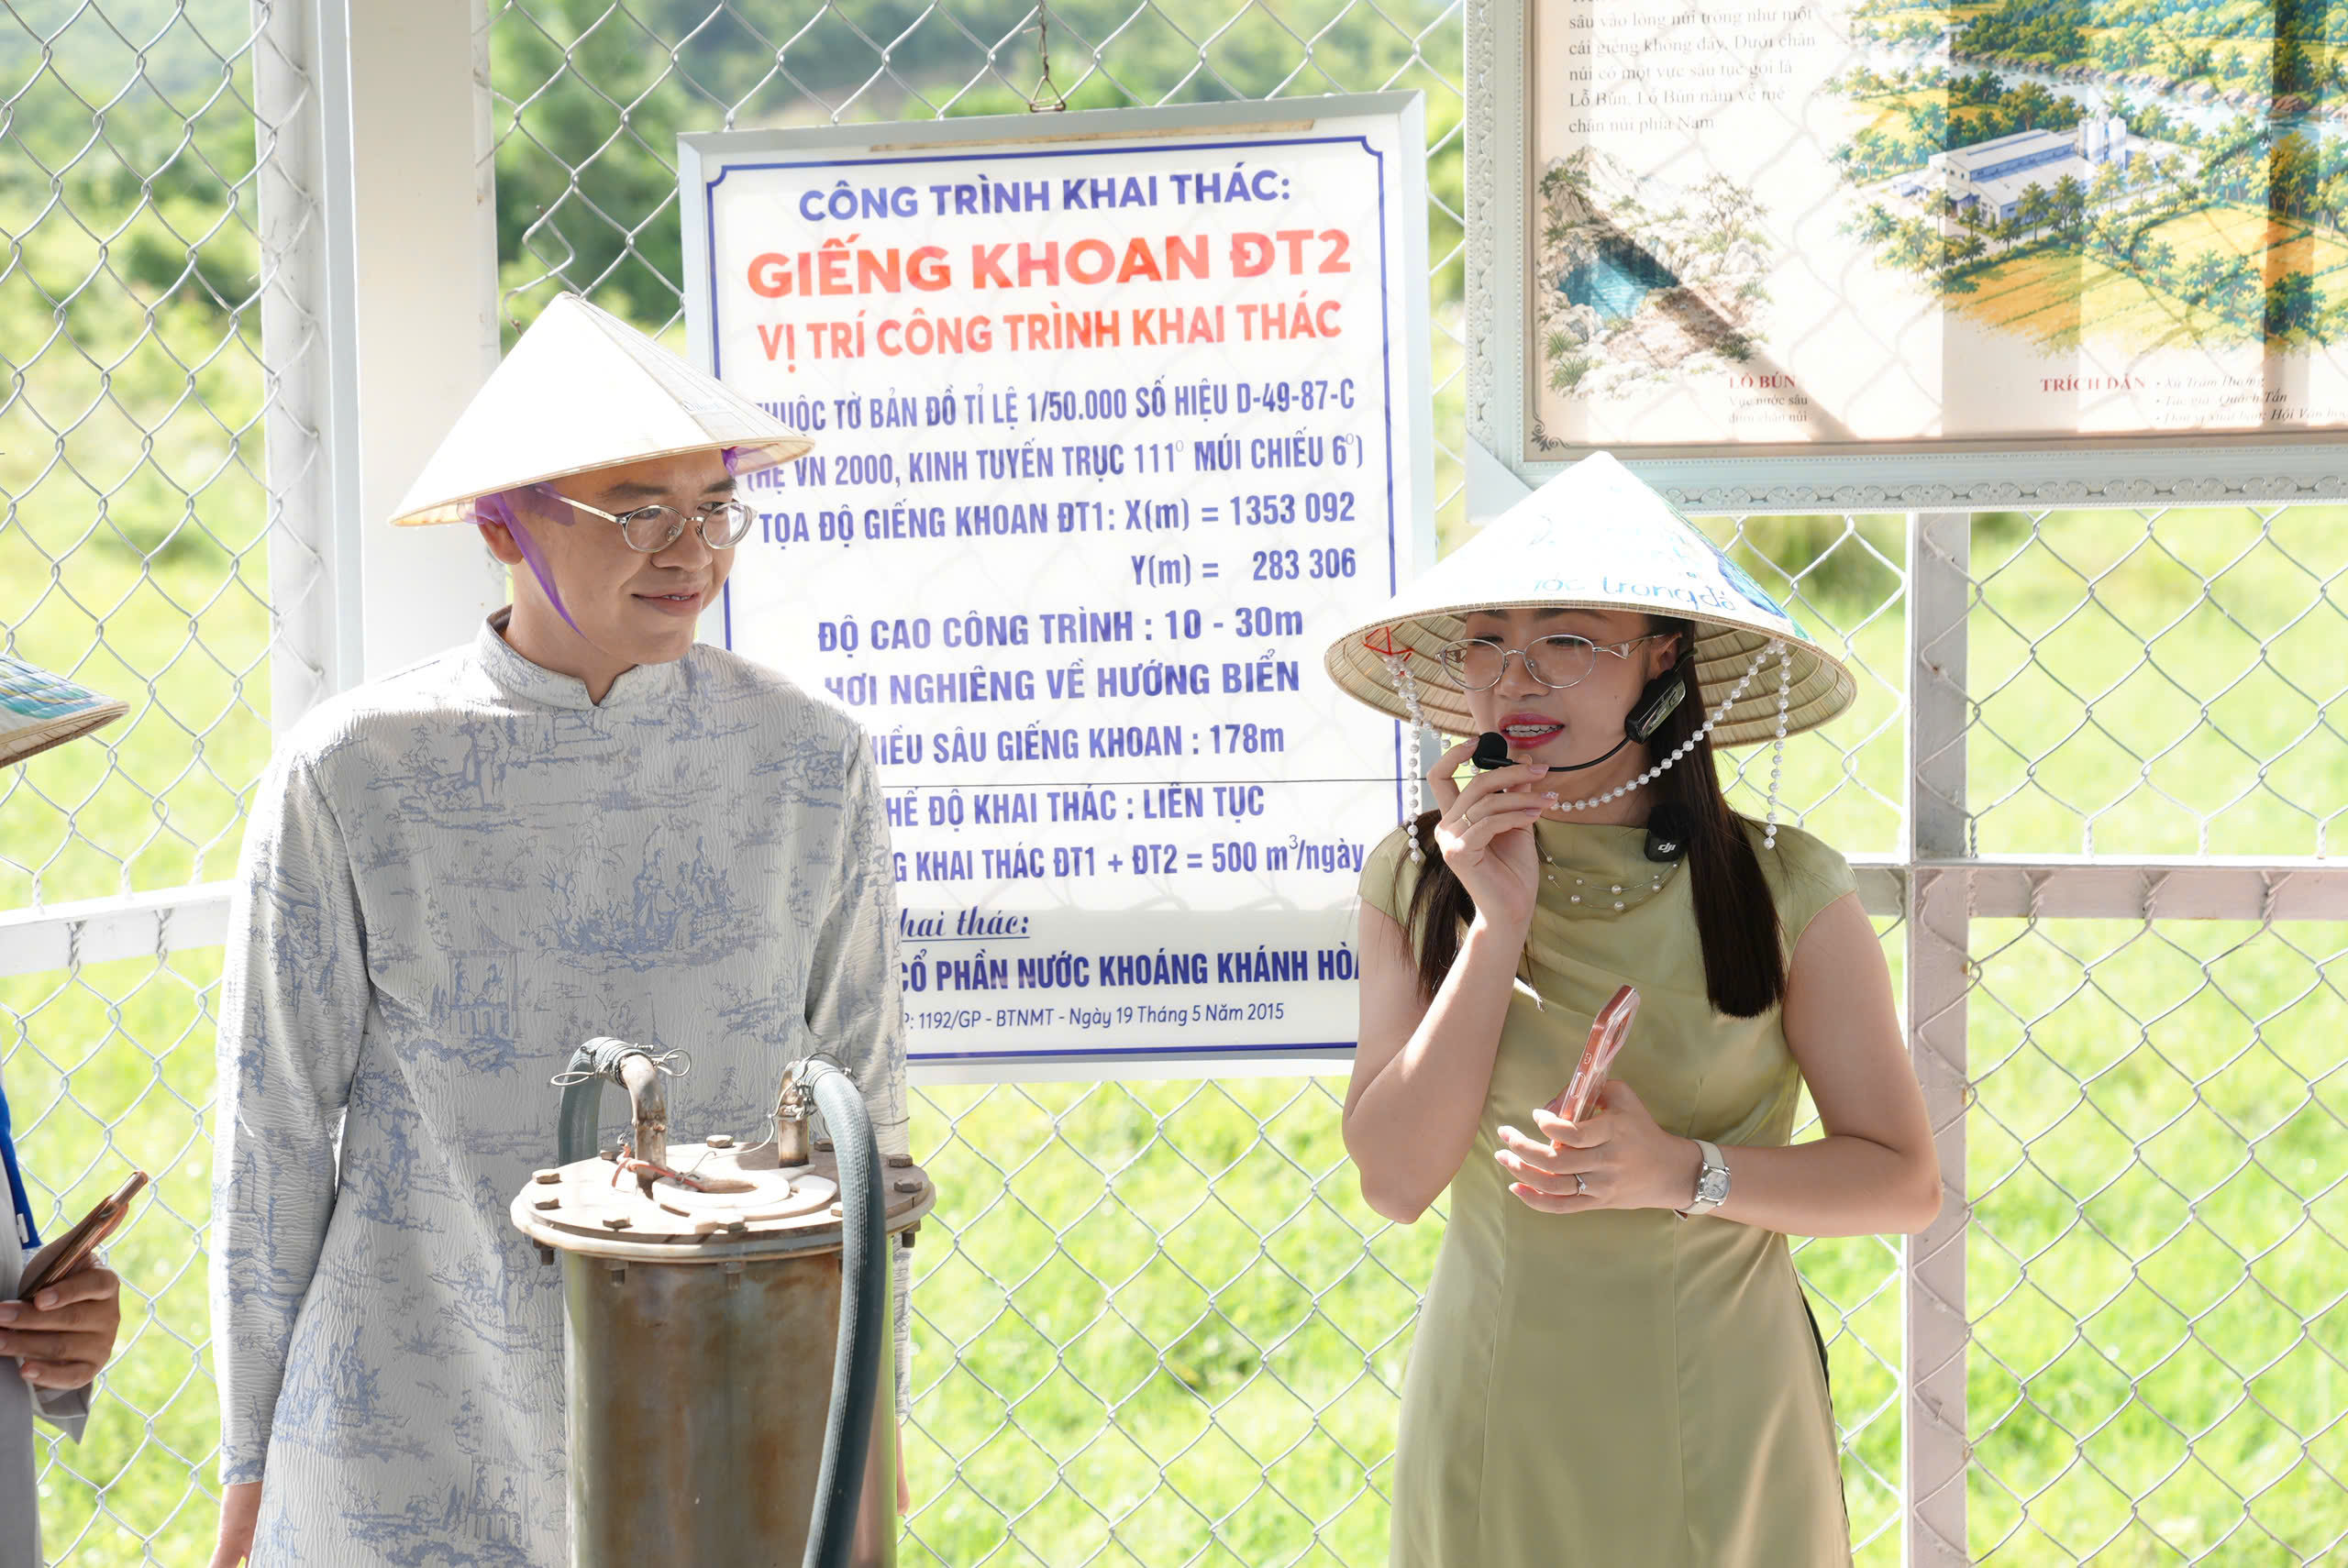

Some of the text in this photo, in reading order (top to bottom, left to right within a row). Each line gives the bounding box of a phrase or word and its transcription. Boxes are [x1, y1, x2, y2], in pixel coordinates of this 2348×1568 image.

[1569, 13, 1594, 29] sâu
[1568, 39, 1591, 55] cái
[1569, 66, 1592, 81] núi
[800, 162, 1289, 221] CÔNG TRÌNH KHAI THÁC:
[748, 229, 1350, 298] GIẾNG KHOAN ĐT2
[758, 291, 1341, 373] VỊ TRÍ CÔNG TRÌNH KHAI THÁC
[1760, 370, 1795, 389] BÚN
[1789, 393, 1808, 406] sâu
[835, 391, 860, 428] TỜ
[871, 387, 917, 427] BẢN
[926, 384, 956, 425] ĐỒ
[964, 383, 984, 425] TỈ
[993, 386, 1017, 429] LỆ
[1027, 389, 1126, 421] 1/50.000
[1136, 375, 1165, 417] SỐ
[1176, 378, 1227, 421] HIỆU
[1237, 379, 1354, 413] D-49-87-C
[794, 456, 826, 486] VN
[836, 455, 901, 488] 2000,
[910, 452, 967, 482] KINH
[977, 437, 1053, 479] TUYẾN
[1063, 445, 1124, 481] TRỤC
[1196, 433, 1240, 469] MÚI
[1252, 426, 1323, 469] CHIẾU
[759, 513, 809, 549] TỌA
[819, 504, 854, 547] ĐỘ
[865, 498, 945, 539] GIẾNG
[957, 504, 1047, 536] KHOAN
[1058, 502, 1113, 532] ĐT1:
[1126, 499, 1189, 532] X(m)
[1231, 494, 1294, 525] 1353
[1306, 491, 1354, 523] 092
[1132, 555, 1190, 587] Y(m)
[1254, 550, 1299, 580] 283
[1310, 548, 1356, 578] 306
[818, 614, 858, 657] ĐỘ
[871, 619, 930, 649] CAO
[944, 611, 1027, 646] CÔNG
[1040, 606, 1132, 644] TRÌNH
[1167, 610, 1201, 638] 10
[1236, 607, 1302, 636] 30m
[891, 666, 1035, 704] NGHIÊNG
[1047, 658, 1084, 699] VỀ
[1098, 660, 1209, 697] HƯỚNG
[1223, 647, 1299, 692] BIỂN
[934, 726, 986, 763] SÂU
[998, 721, 1079, 761] GIẾNG
[1090, 726, 1181, 757] KHOAN
[1211, 723, 1284, 753] 178m
[886, 787, 917, 826] HẾ
[929, 790, 964, 831] ĐỘ
[975, 794, 1036, 823] KHAI
[1047, 784, 1115, 822] THÁC
[1213, 786, 1264, 823] TỤC
[917, 851, 972, 880] KHAI
[983, 842, 1045, 878] THÁC
[1054, 847, 1093, 877] ĐT1
[1133, 845, 1177, 874] ĐT2
[1213, 842, 1257, 872] 500
[900, 906, 1028, 938] hai thác:
[936, 949, 1008, 990] PHẦN
[1017, 950, 1090, 988] NƯỚC
[1100, 947, 1208, 987] KHOÁNG
[1218, 945, 1308, 983] KHÁNH
[919, 1010, 981, 1030] 1192/GP
[997, 1009, 1055, 1027] BTNMT
[1069, 1008, 1112, 1030] Ngày
[1117, 1007, 1133, 1022] 19
[1137, 1006, 1188, 1026] Tháng
[1192, 1005, 1201, 1021] 5
[1206, 1005, 1243, 1020] Năm
[1247, 1003, 1284, 1020] 2015
